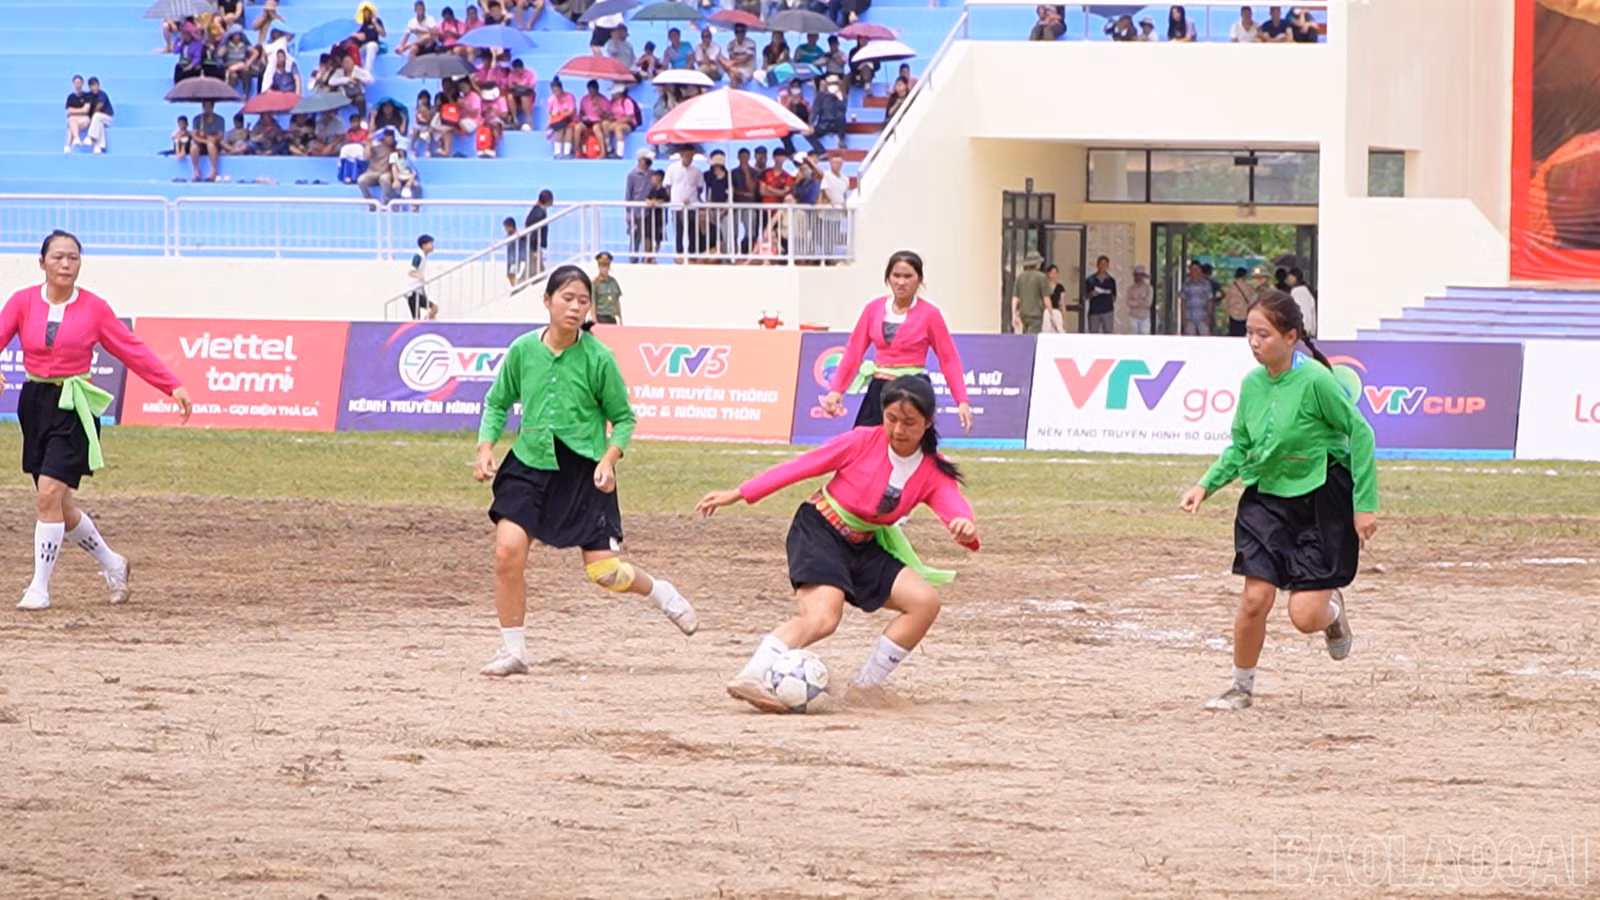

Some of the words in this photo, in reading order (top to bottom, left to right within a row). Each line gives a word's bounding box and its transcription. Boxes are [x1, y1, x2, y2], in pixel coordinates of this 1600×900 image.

[179, 332, 298, 360] viettel
[639, 343, 731, 377] VTV5
[1054, 358, 1186, 410] VTV
[1183, 388, 1235, 422] go
[1363, 386, 1427, 415] VTV
[1423, 396, 1487, 414] CUP
[192, 403, 222, 414] DATA
